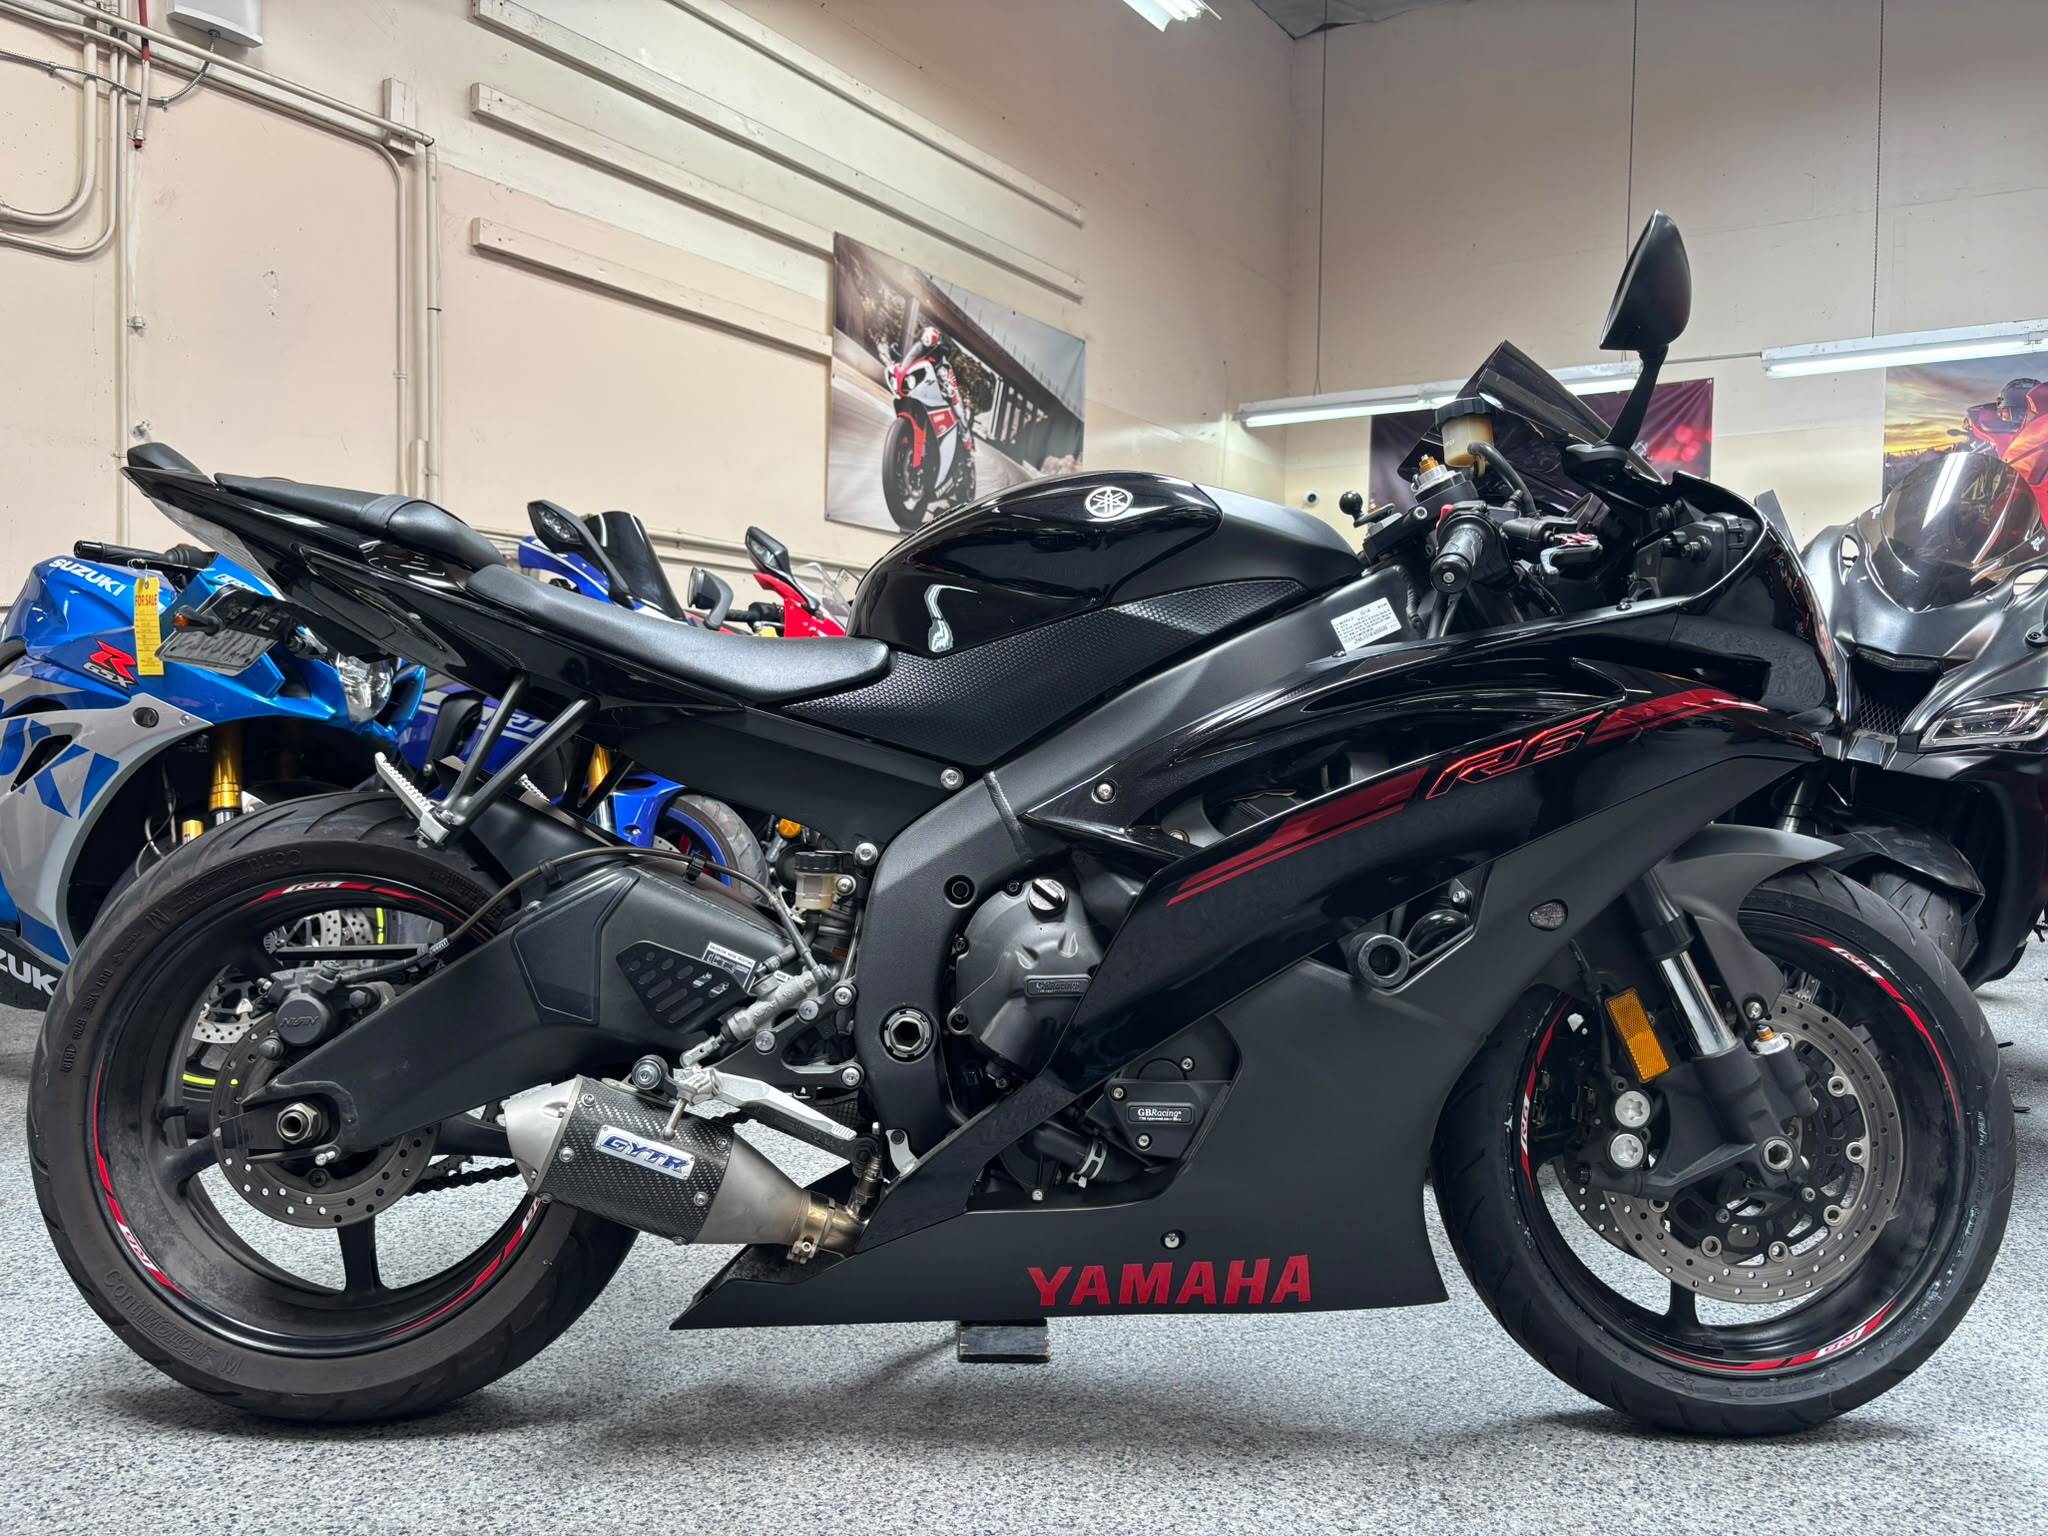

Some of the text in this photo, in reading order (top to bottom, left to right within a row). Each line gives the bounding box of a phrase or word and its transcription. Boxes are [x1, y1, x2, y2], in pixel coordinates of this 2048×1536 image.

[49, 559, 127, 597] SUZUKI
[83, 661, 139, 688] GSX
[1425, 710, 1604, 800] R6
[601, 1135, 690, 1174] GYTR
[1027, 1254, 1312, 1306] YAMAHA
